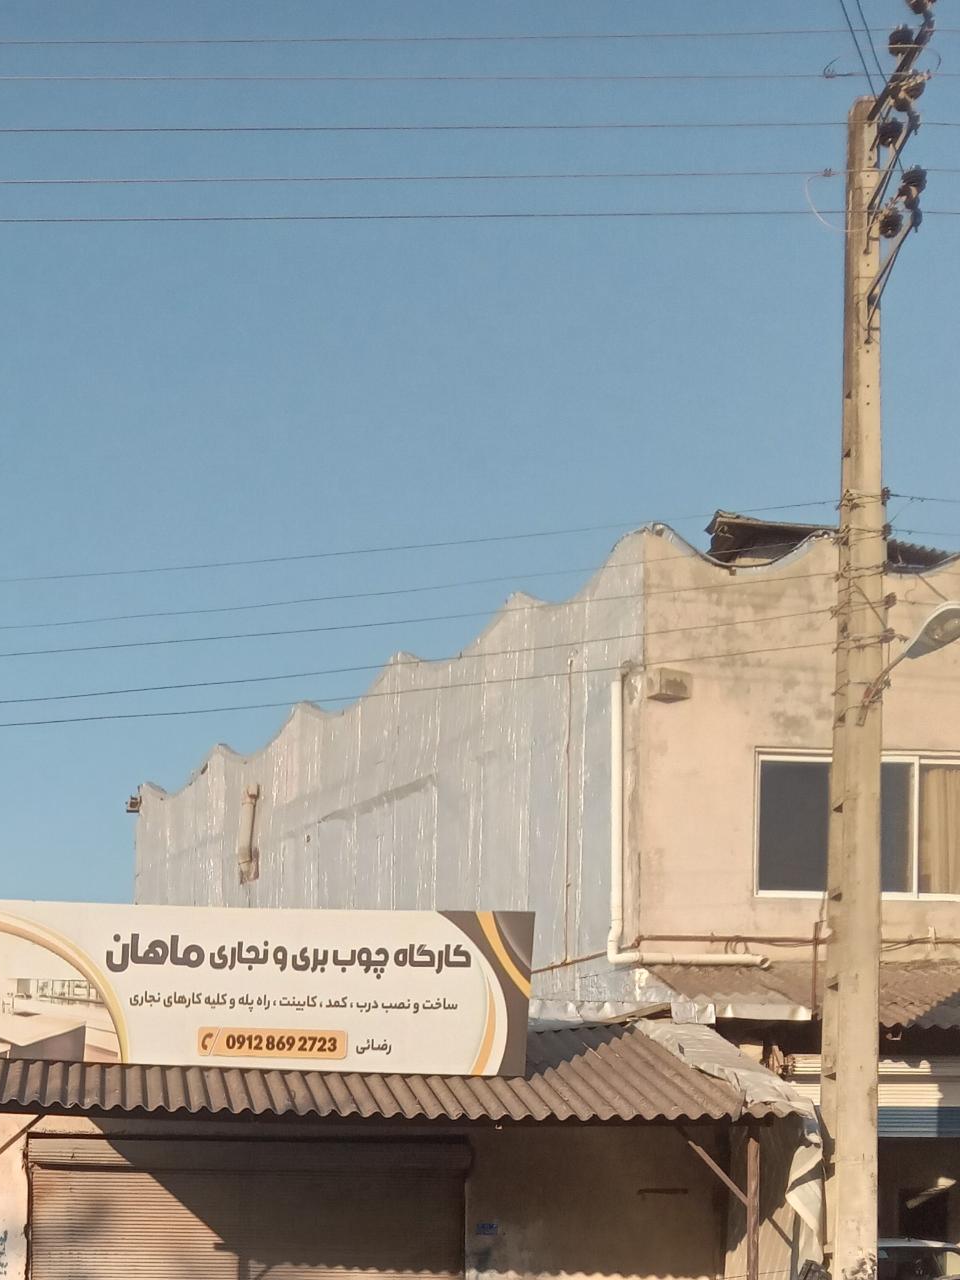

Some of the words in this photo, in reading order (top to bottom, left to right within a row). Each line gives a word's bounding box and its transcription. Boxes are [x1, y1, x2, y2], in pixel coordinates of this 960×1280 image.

[106, 933, 205, 973] ماهان
[209, 940, 269, 971] نجاری
[273, 945, 288, 972] و
[291, 946, 328, 973] بری
[394, 943, 472, 974] کارگاه
[332, 946, 389, 980] چوب
[130, 990, 161, 1007] نجاری
[163, 991, 202, 1008] کارهای
[204, 993, 227, 1009] کلیه
[229, 998, 236, 1009] و
[239, 993, 254, 1012] پله
[256, 994, 271, 1010] راه
[381, 999, 411, 1013] نصب
[422, 997, 458, 1011] ساخت
[413, 1002, 420, 1014] و
[225, 1034, 263, 1051] 0912
[265, 1035, 296, 1051] 869
[297, 1036, 338, 1052] 2723
